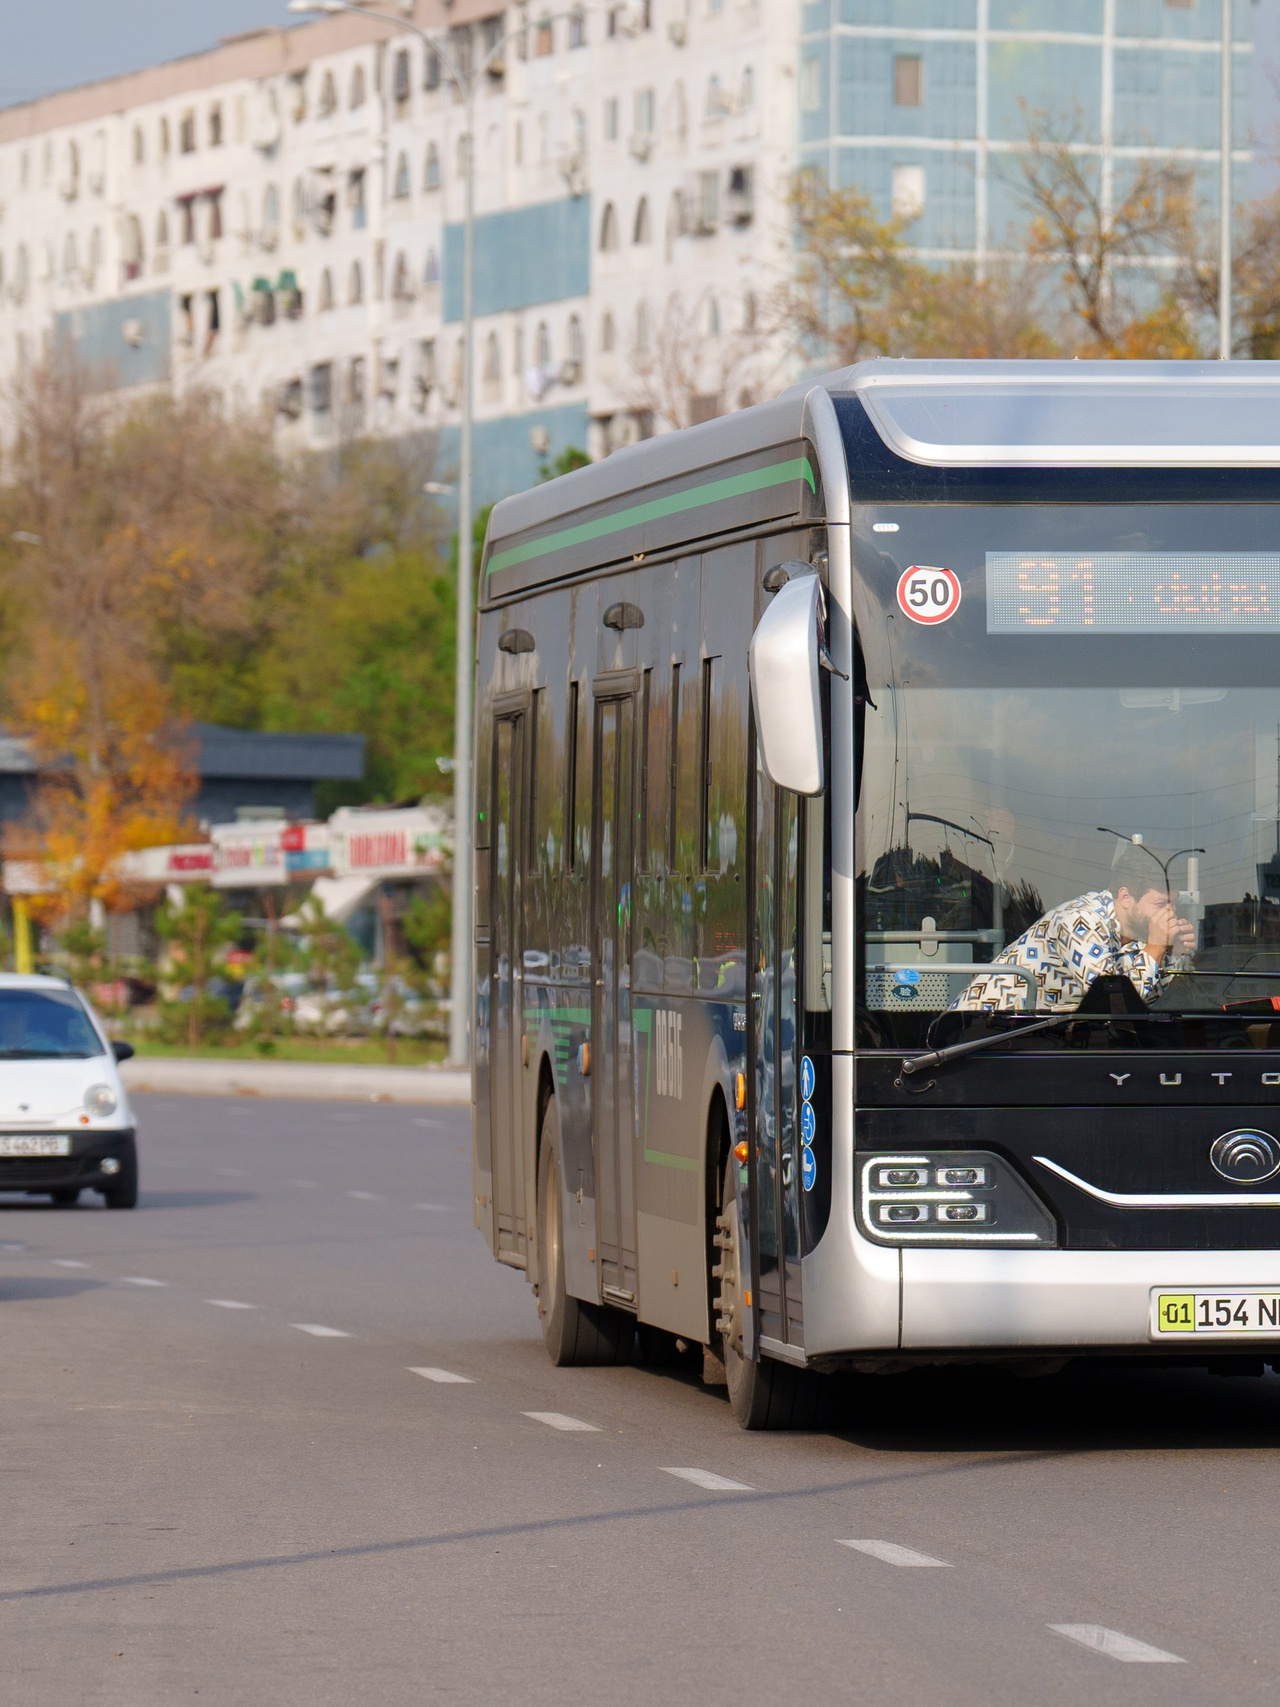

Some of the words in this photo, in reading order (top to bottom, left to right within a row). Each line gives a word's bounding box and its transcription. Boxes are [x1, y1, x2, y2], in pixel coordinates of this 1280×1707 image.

[909, 578, 950, 607] 50
[1018, 561, 1094, 625] 91
[1166, 1303, 1192, 1324] 01
[1198, 1299, 1249, 1327] 154
